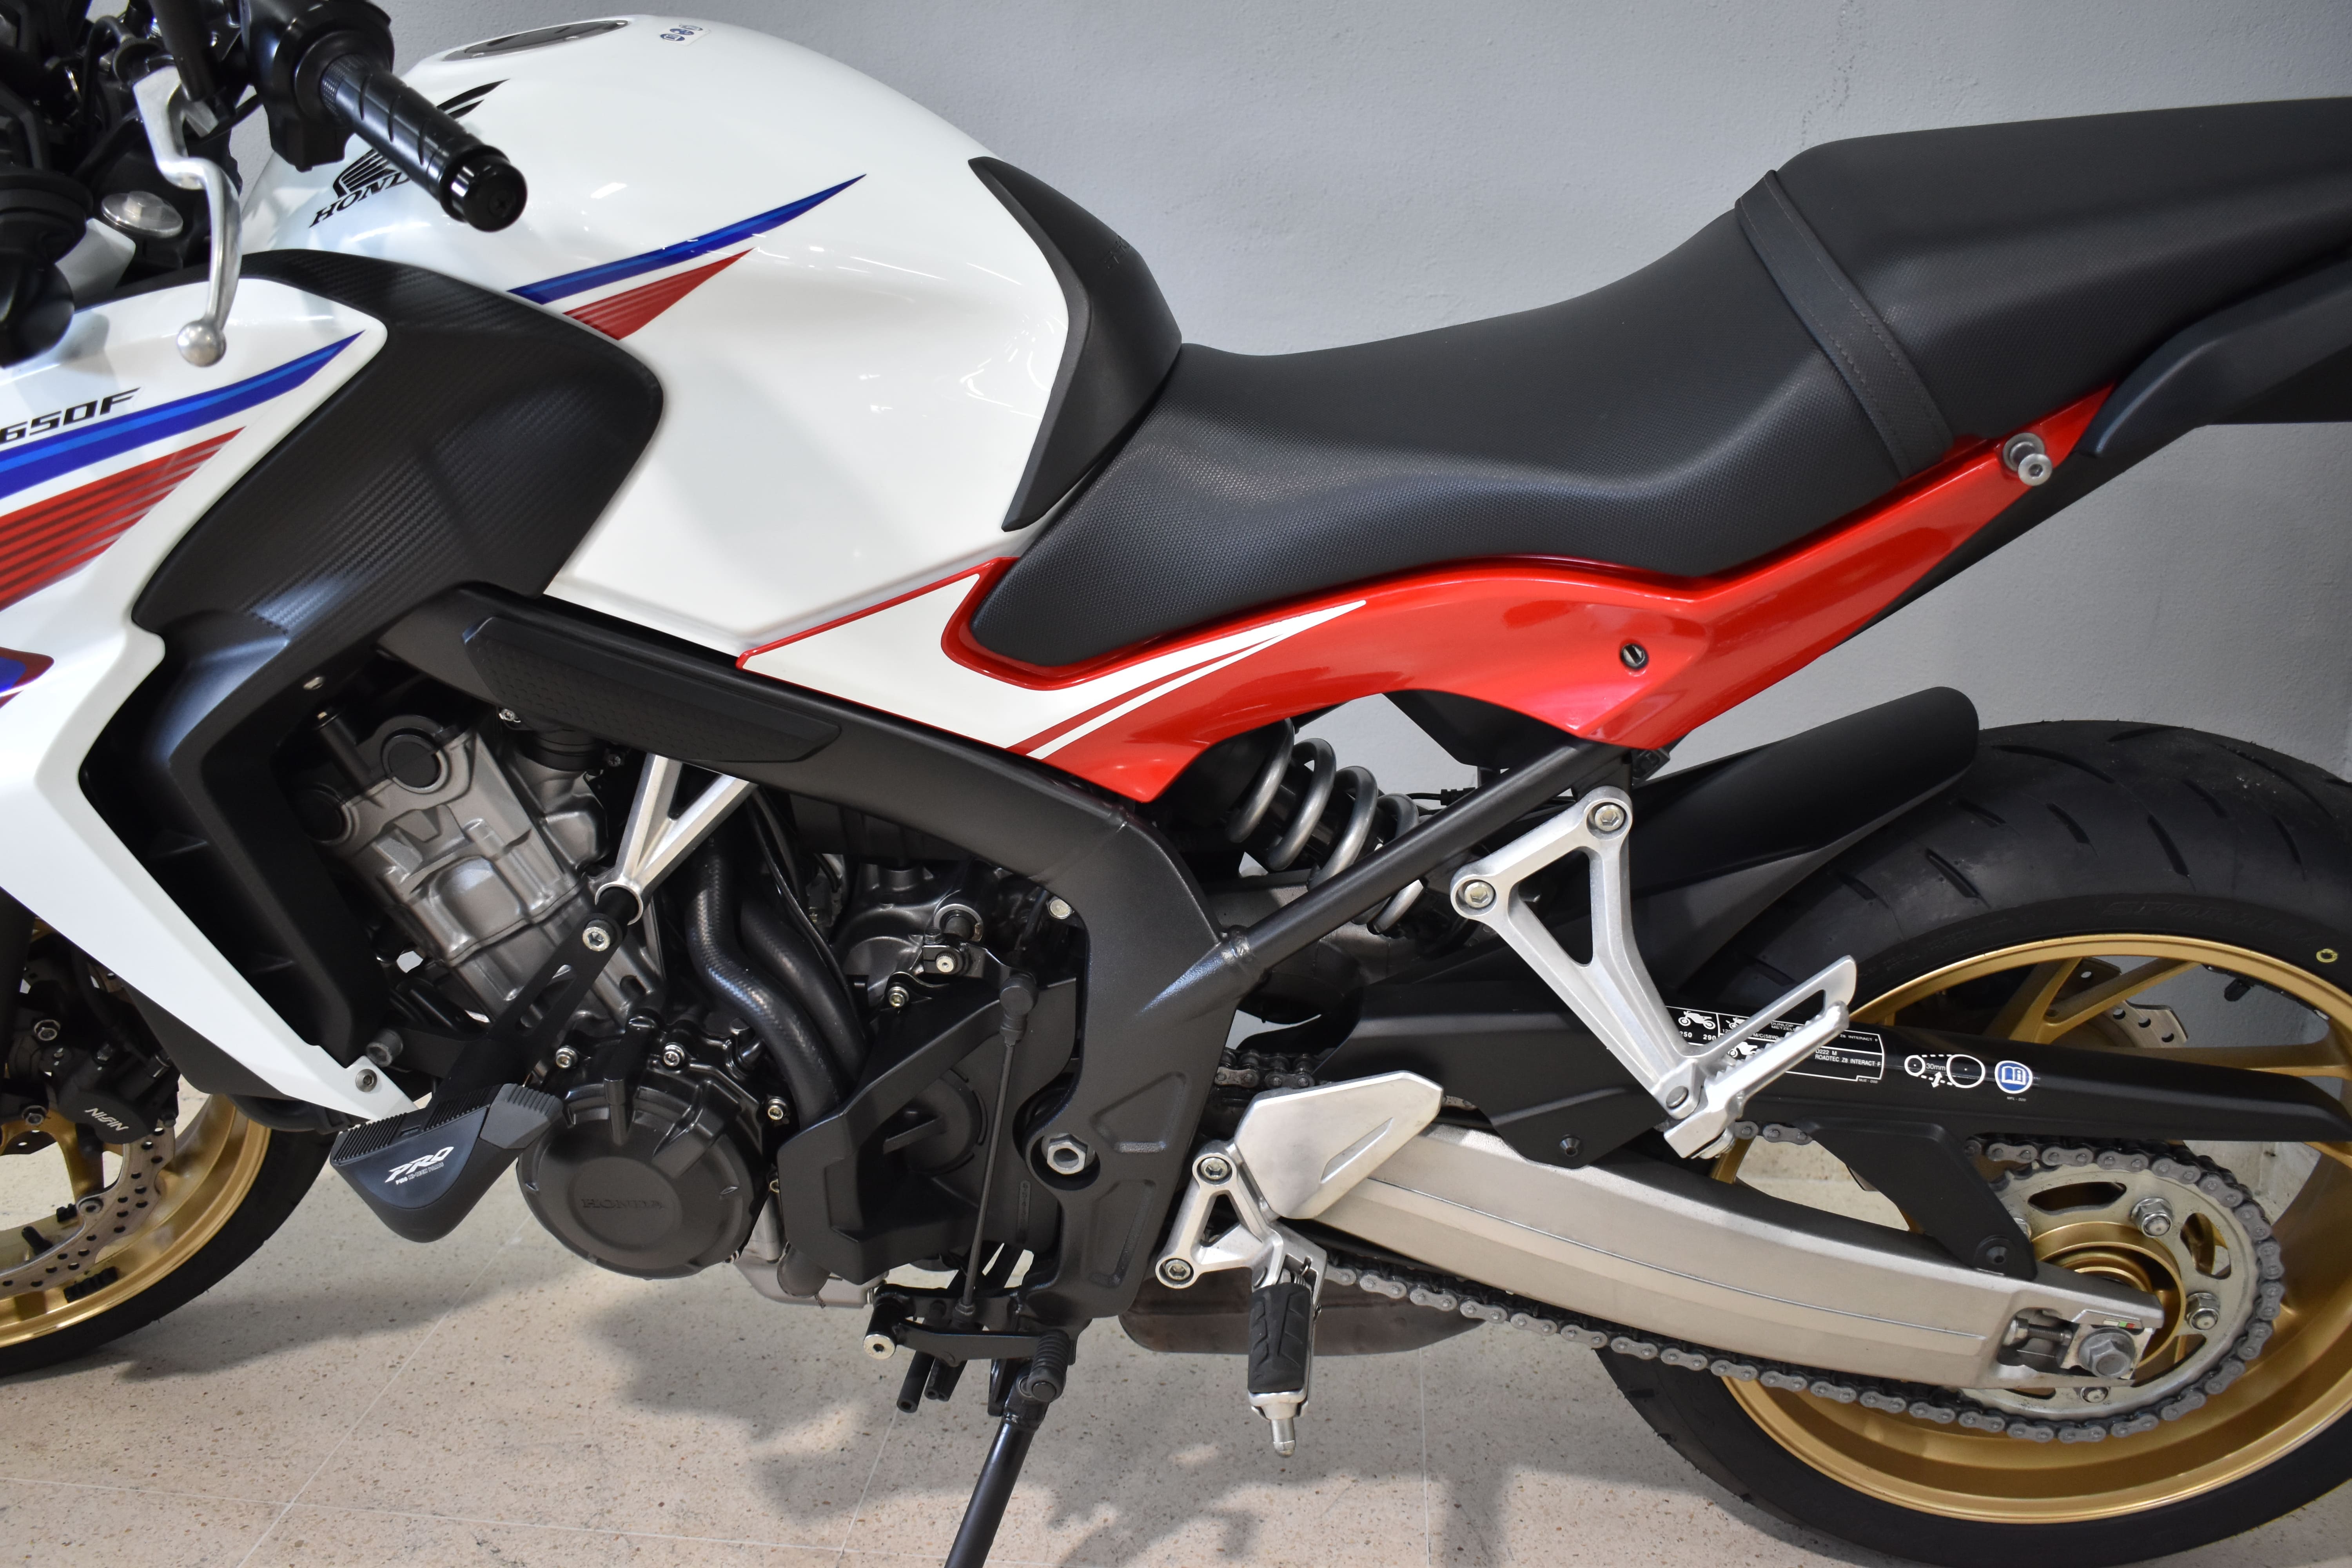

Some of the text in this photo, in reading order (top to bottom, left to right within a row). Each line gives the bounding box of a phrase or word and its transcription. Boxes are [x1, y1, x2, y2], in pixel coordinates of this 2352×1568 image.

[309, 172, 411, 228] HOND
[0, 387, 141, 445] 650F
[1815, 1054, 1840, 1062] ROADTEC
[1850, 1058, 1875, 1067] INTERACT
[1926, 1062, 1946, 1071] 30mm
[84, 1107, 129, 1131] NISSIN
[385, 1146, 454, 1183] PRO
